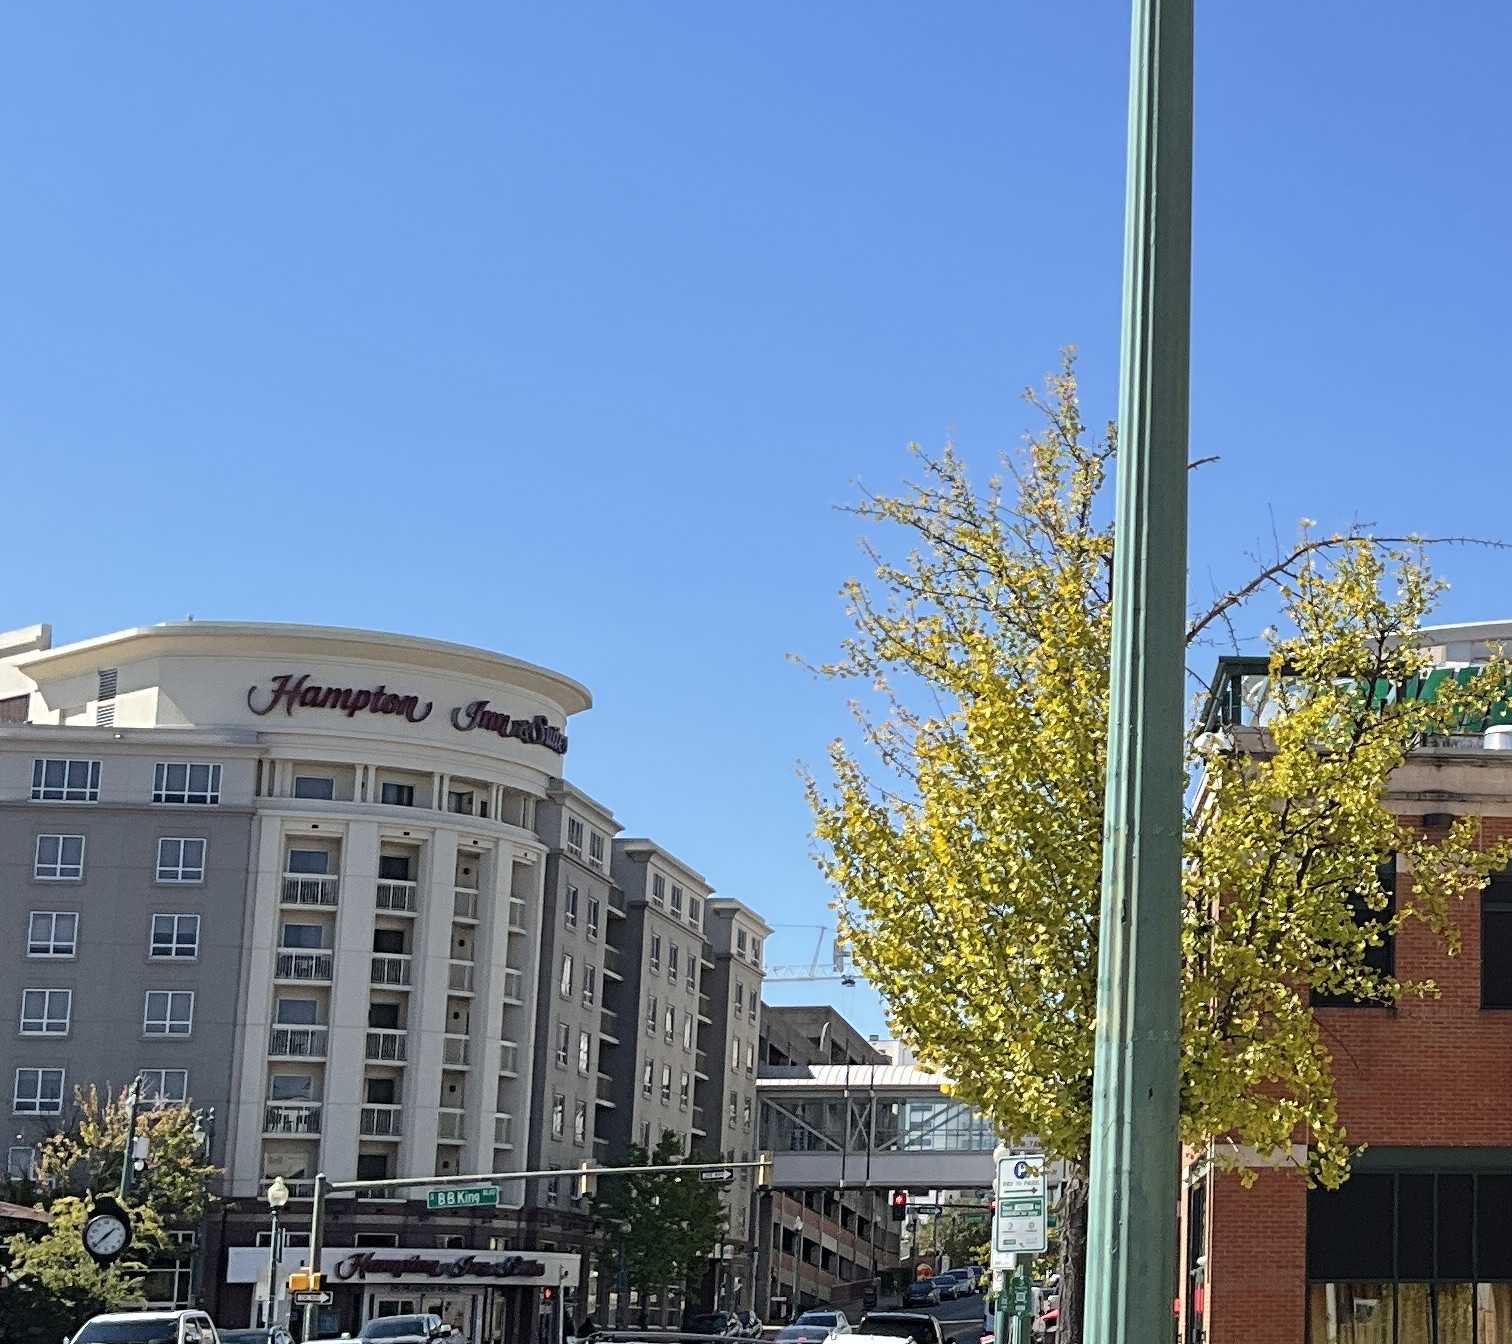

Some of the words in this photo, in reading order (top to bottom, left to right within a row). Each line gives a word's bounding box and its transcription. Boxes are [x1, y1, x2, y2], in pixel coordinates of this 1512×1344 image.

[247, 674, 433, 723] Hampton
[450, 700, 511, 738] Inn
[457, 1190, 480, 1205] King
